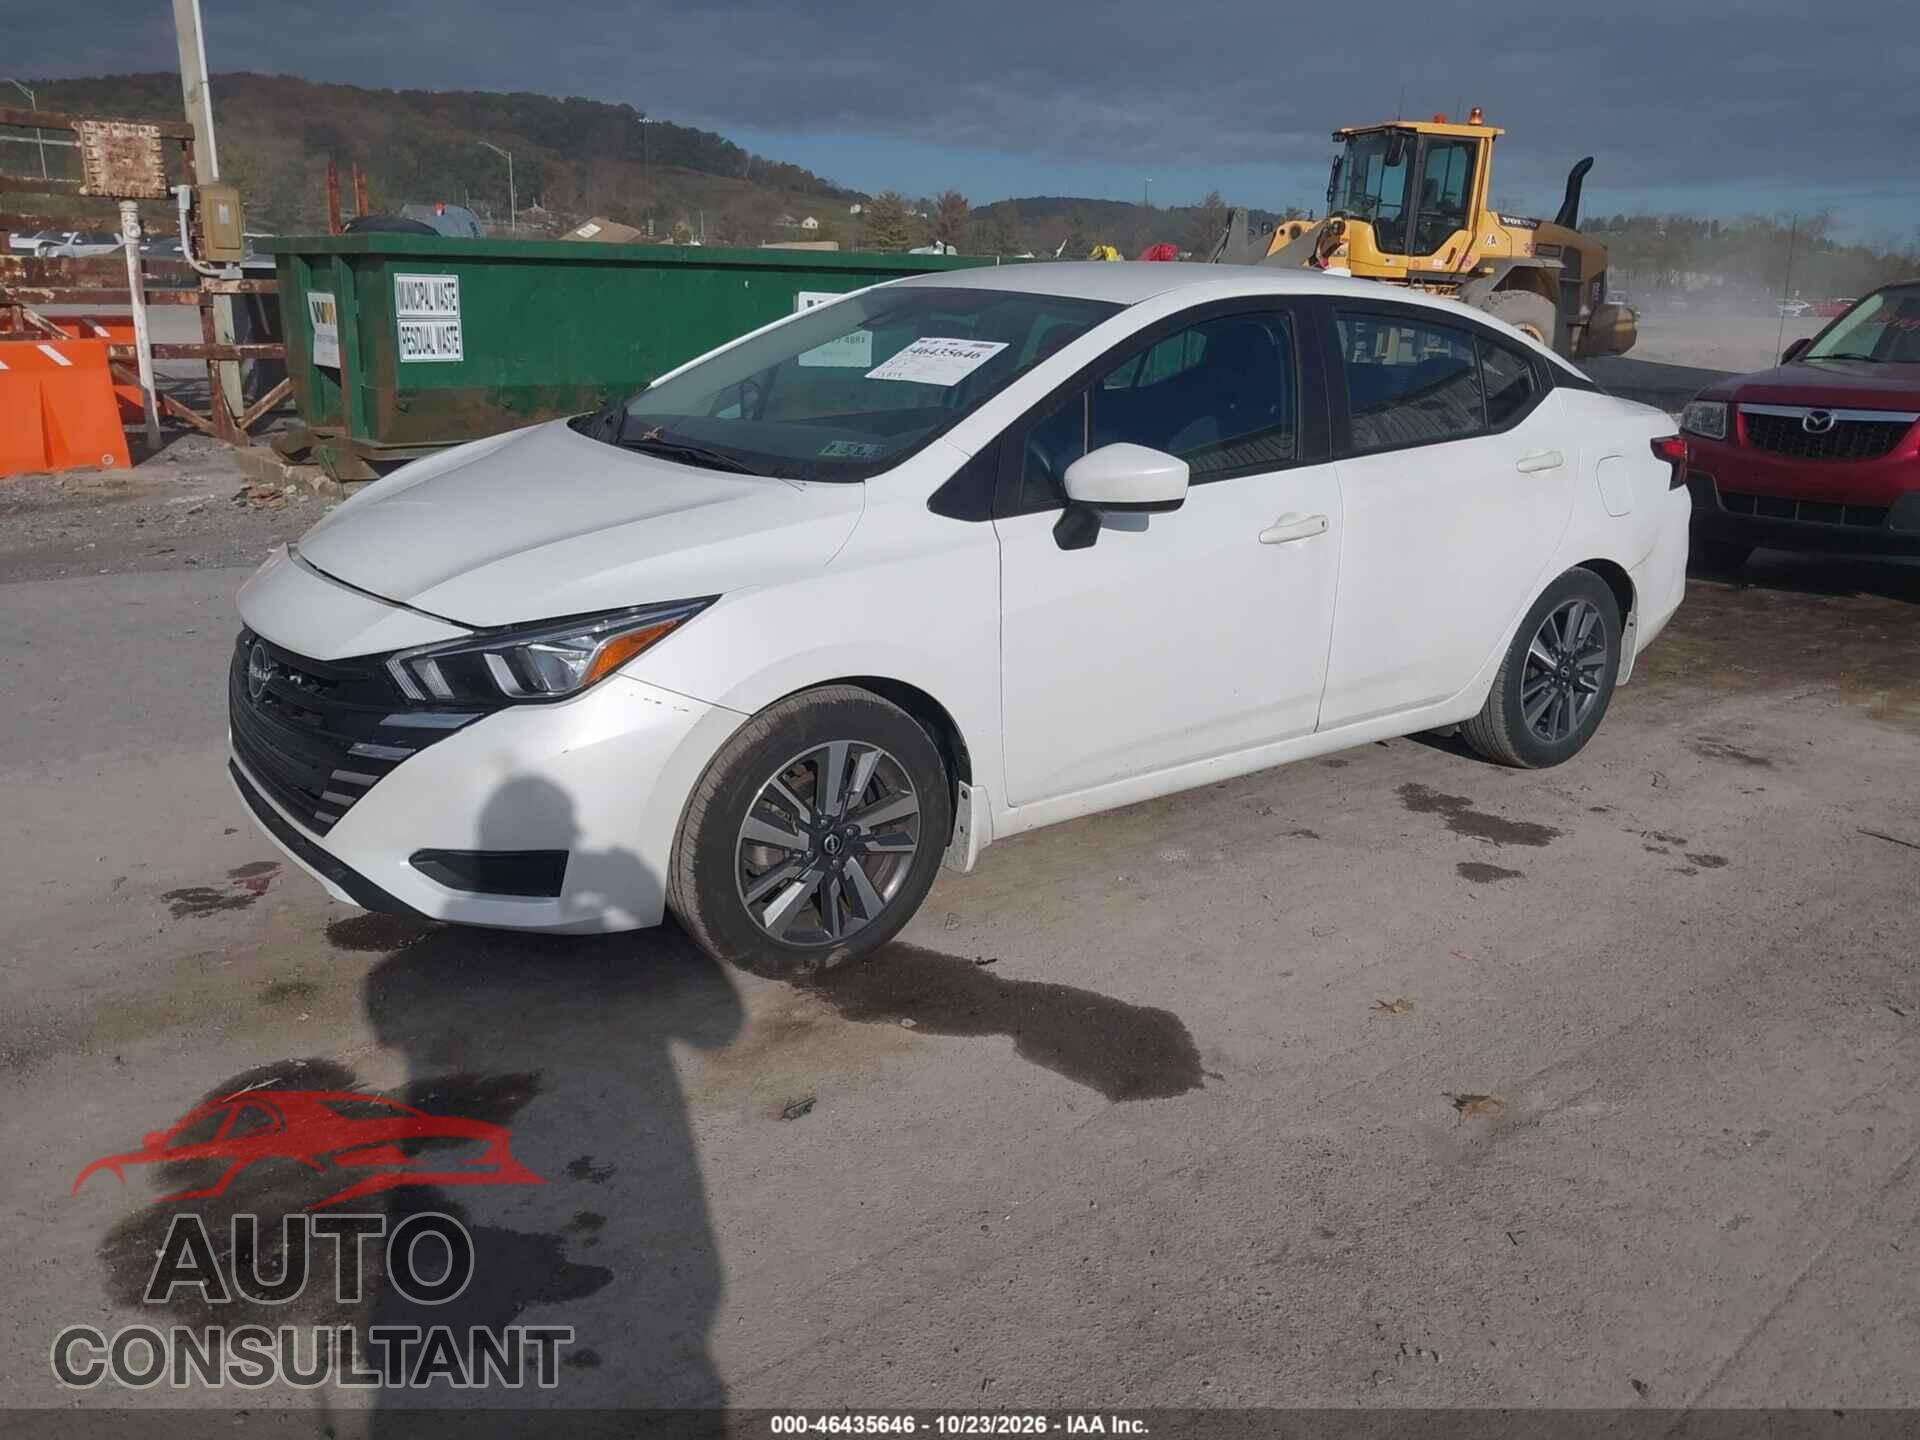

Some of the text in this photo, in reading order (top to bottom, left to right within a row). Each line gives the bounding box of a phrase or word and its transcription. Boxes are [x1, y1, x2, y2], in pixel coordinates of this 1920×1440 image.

[1502, 216, 1537, 228] VOLVO
[433, 282, 456, 311] WASTE
[401, 325, 459, 355] RESIDUAL WASTE
